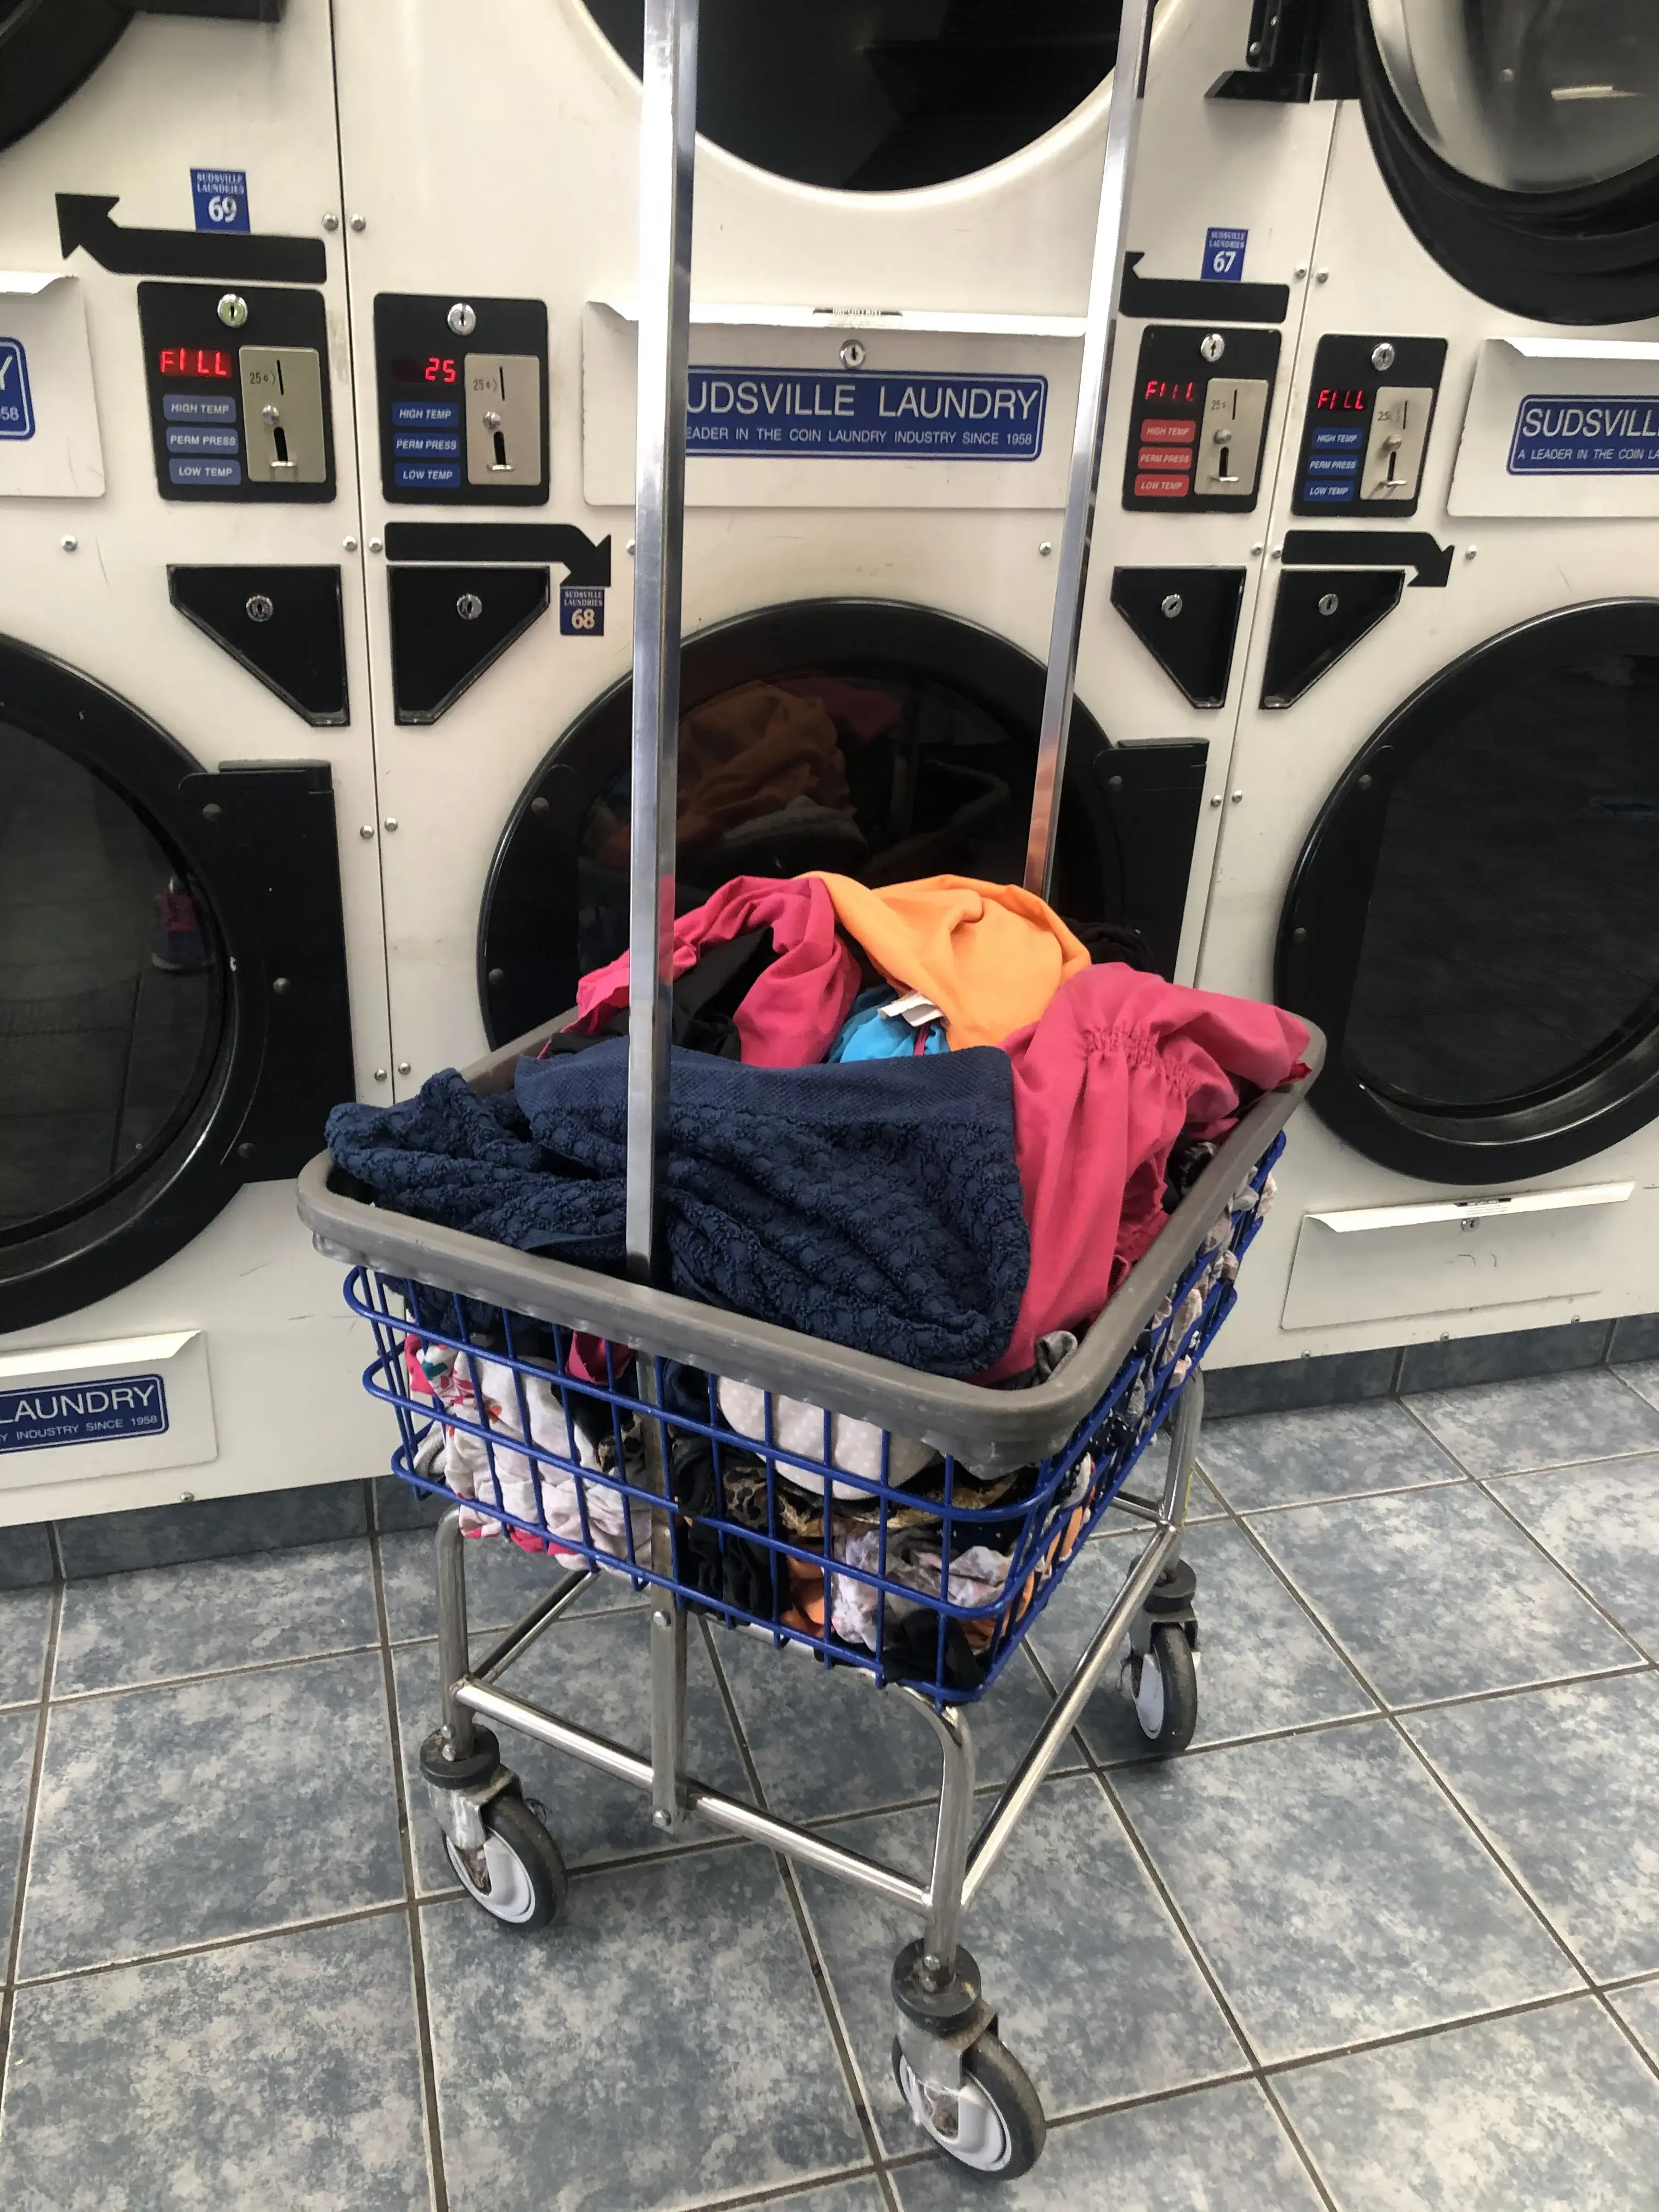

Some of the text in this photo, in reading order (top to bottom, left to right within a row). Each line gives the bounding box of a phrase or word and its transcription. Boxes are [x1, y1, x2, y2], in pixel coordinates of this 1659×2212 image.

[208, 195, 237, 223] 69
[1213, 250, 1237, 273] 67
[160, 347, 227, 376] FILL
[425, 357, 456, 382] 25
[687, 380, 1039, 420] UDSVILLE LAUNDRY
[1317, 388, 1365, 410] FILL
[0, 405, 19, 421] 58
[171, 403, 229, 415] HIGH TEMP
[399, 408, 452, 420] HIGH TEMP
[1522, 408, 1659, 438] SUDSVILL
[686, 426, 1032, 446] EADER IN THE COIN LAUNDRY INDUSTRY SINCE 1958
[1146, 427, 1190, 436] HIGH TEMP
[170, 434, 236, 447] PERM PRESS
[396, 438, 457, 450] PERM PRESS
[1317, 434, 1358, 444] HIGH TEMP
[1139, 454, 1190, 464] PERM PRESS
[1517, 449, 1526, 460] A
[1530, 448, 1573, 460] LEADER
[1576, 449, 1589, 460] IN
[1593, 448, 1615, 460] THE
[1618, 448, 1645, 460] COIN
[1309, 460, 1357, 470] PERM PRESS
[178, 466, 233, 477] LOW TEMP
[402, 470, 453, 481] LOW TEMP
[1141, 481, 1183, 490] LOW TEMP
[1309, 487, 1350, 496] LOW TEMP
[565, 590, 602, 599] SUDSVILLE
[571, 608, 595, 630] 68
[16, 1424, 80, 1441] INDUSTRY
[85, 1419, 124, 1432] SINCE
[131, 1415, 158, 1426] 1958
